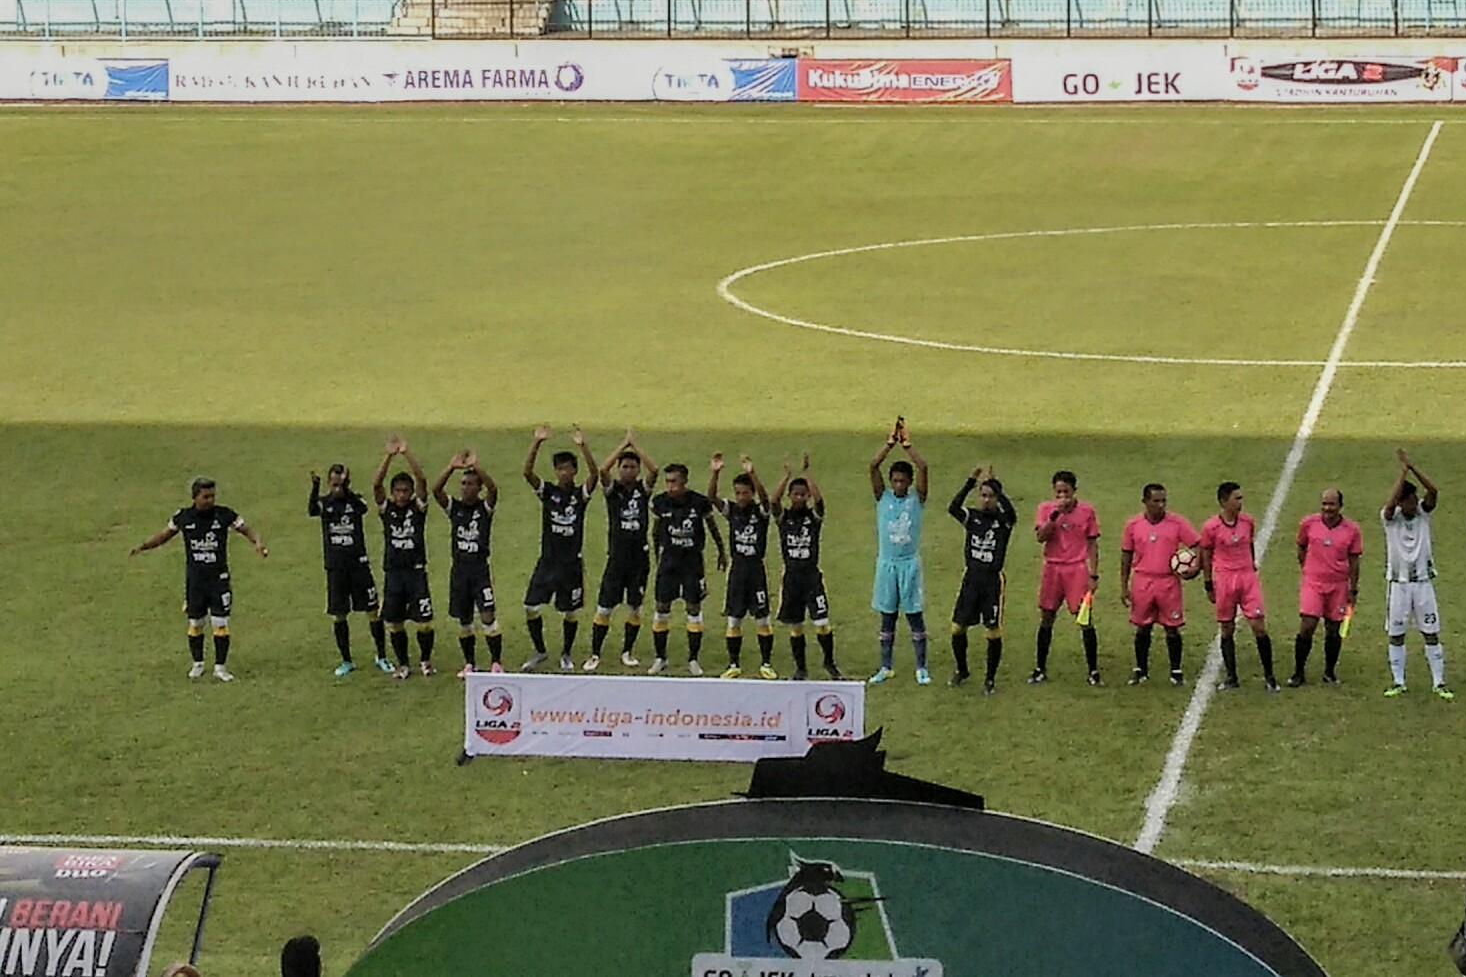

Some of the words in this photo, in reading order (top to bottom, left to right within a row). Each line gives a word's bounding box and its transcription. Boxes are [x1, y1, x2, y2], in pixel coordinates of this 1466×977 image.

[403, 69, 474, 89] AREMA
[481, 69, 549, 89] FARMA
[1292, 60, 1359, 80] LIGA
[1063, 74, 1099, 95] GO
[1135, 73, 1182, 95] JEK
[475, 719, 507, 729] LIGA
[530, 707, 781, 729] www.liga-indonesia.id
[807, 728, 840, 737] LIGA
[10, 897, 123, 928] BERANI
